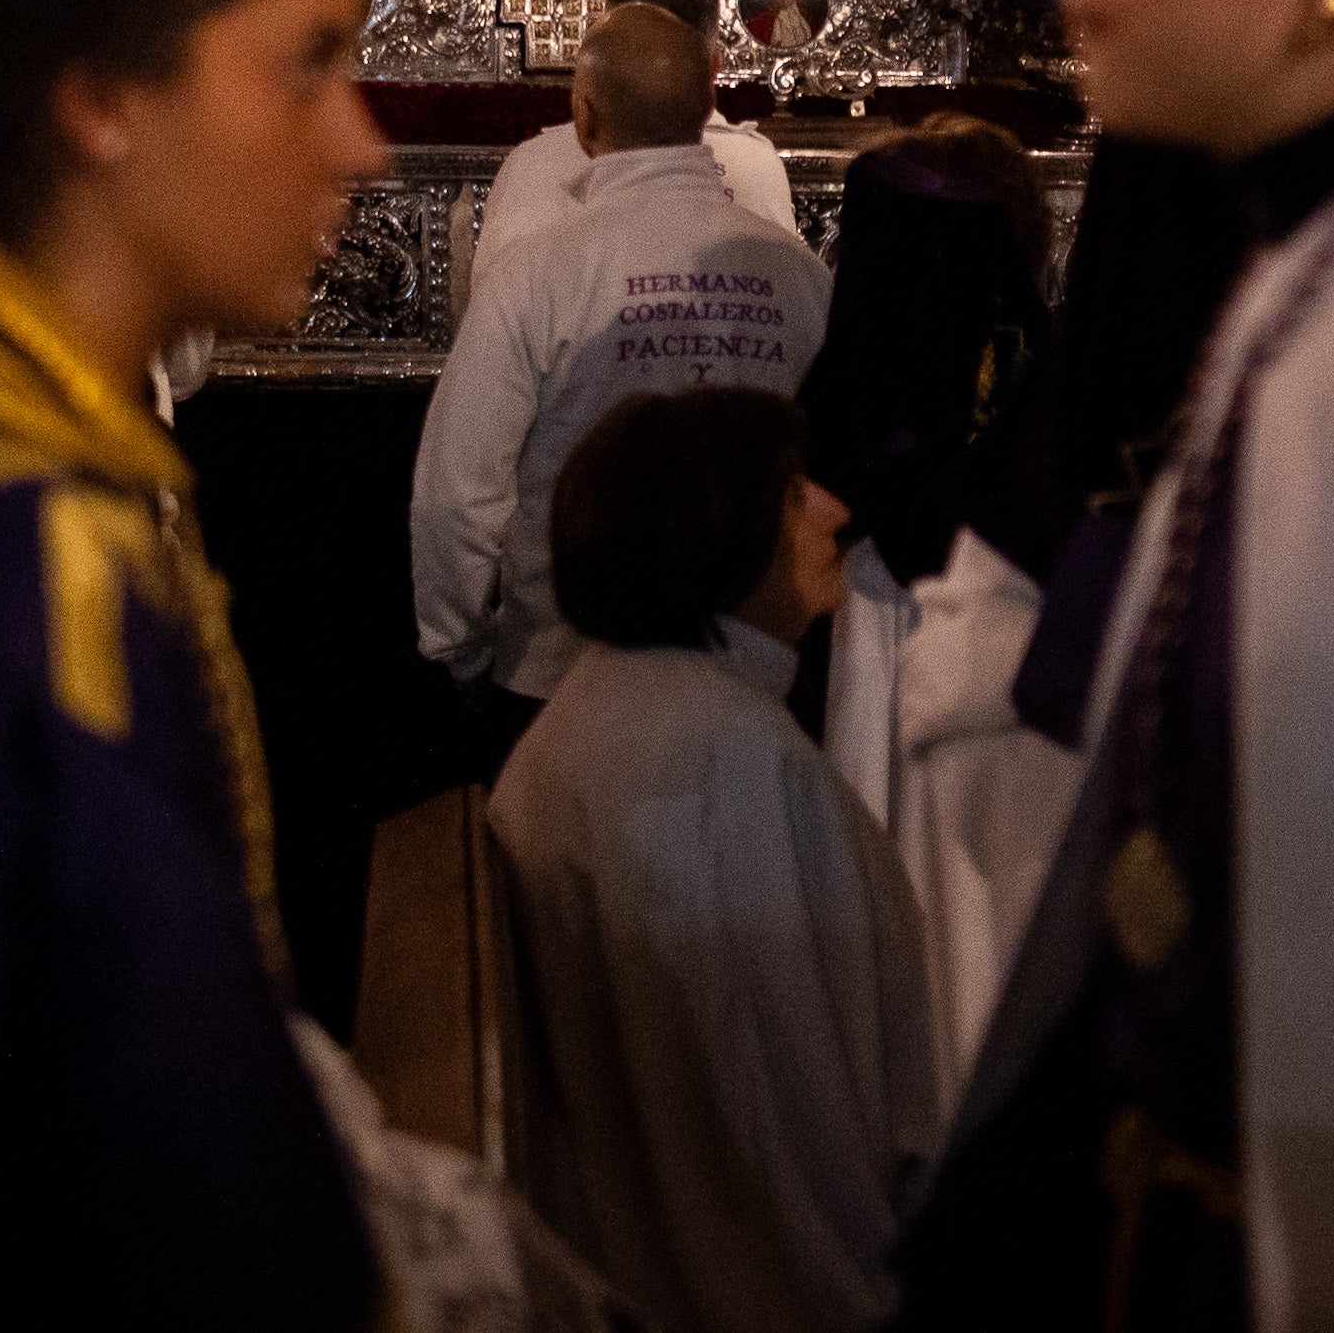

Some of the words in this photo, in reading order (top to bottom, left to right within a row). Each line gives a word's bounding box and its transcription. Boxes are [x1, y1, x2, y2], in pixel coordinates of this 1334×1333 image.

[625, 273, 774, 297] HERMANOS
[619, 301, 784, 326] COSTALEROS
[617, 334, 786, 363] PACIENCIA
[690, 362, 713, 384] Y
